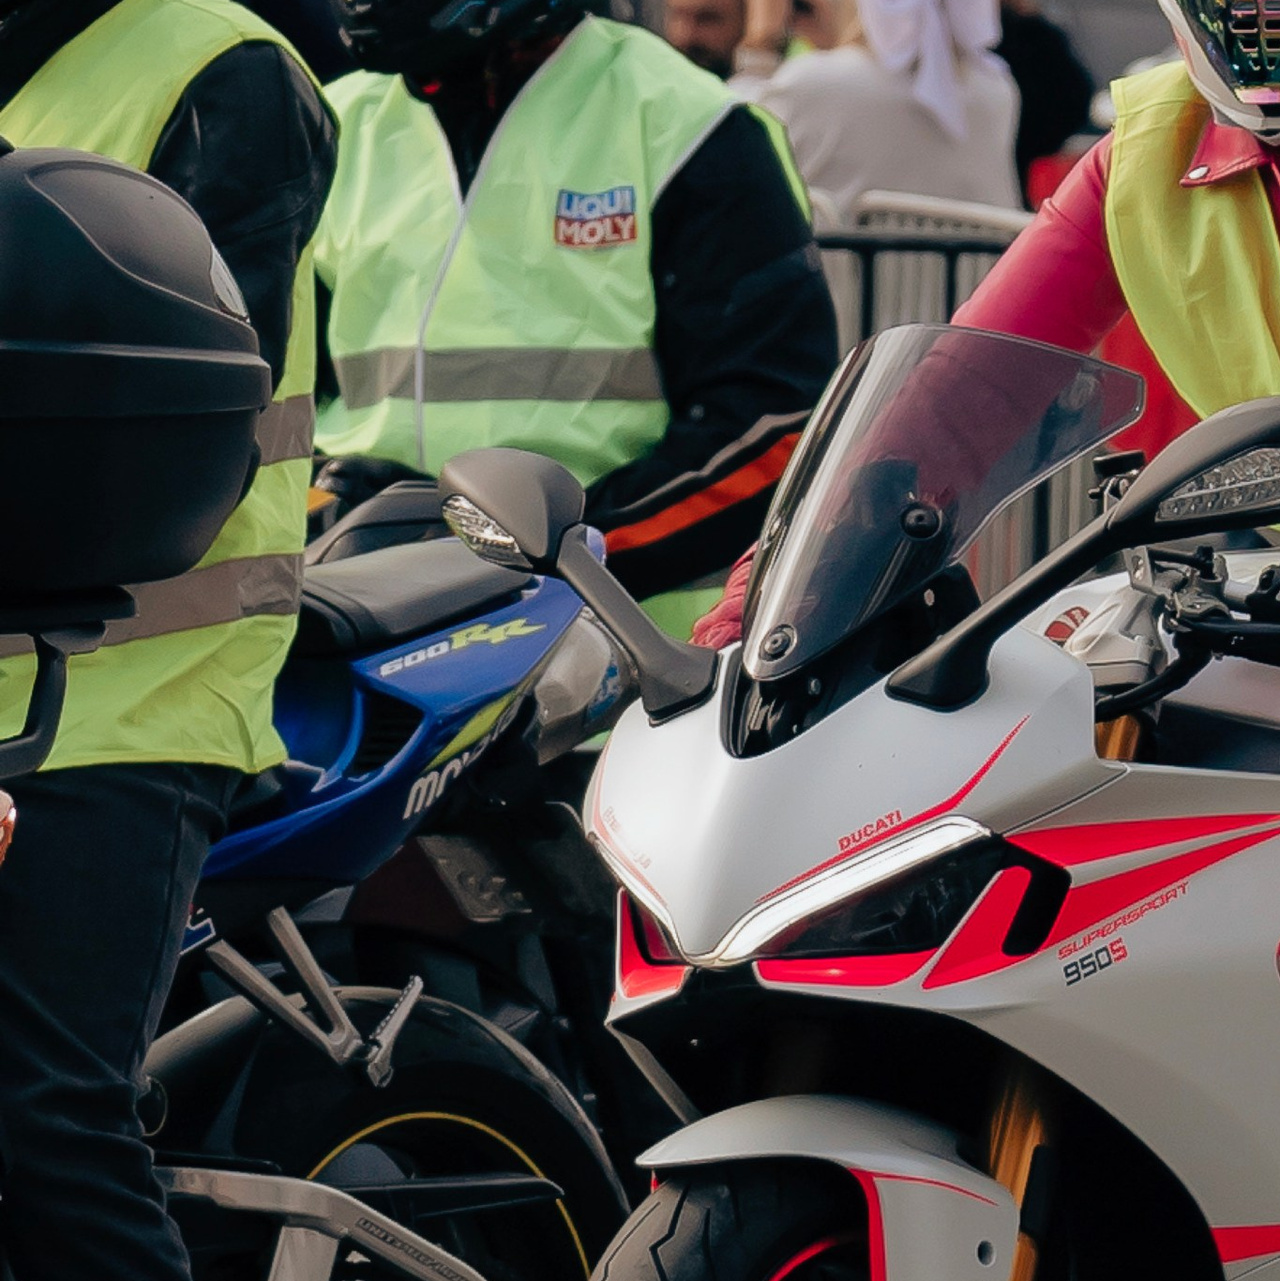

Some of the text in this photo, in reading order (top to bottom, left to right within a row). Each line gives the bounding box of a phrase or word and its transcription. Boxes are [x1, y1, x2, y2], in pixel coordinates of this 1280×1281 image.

[558, 189, 633, 220] LIQUI
[558, 214, 634, 245] MOLY
[838, 809, 902, 851] DUCATI
[1057, 880, 1189, 960] SUPERSPORT
[1063, 937, 1128, 986] 950S
